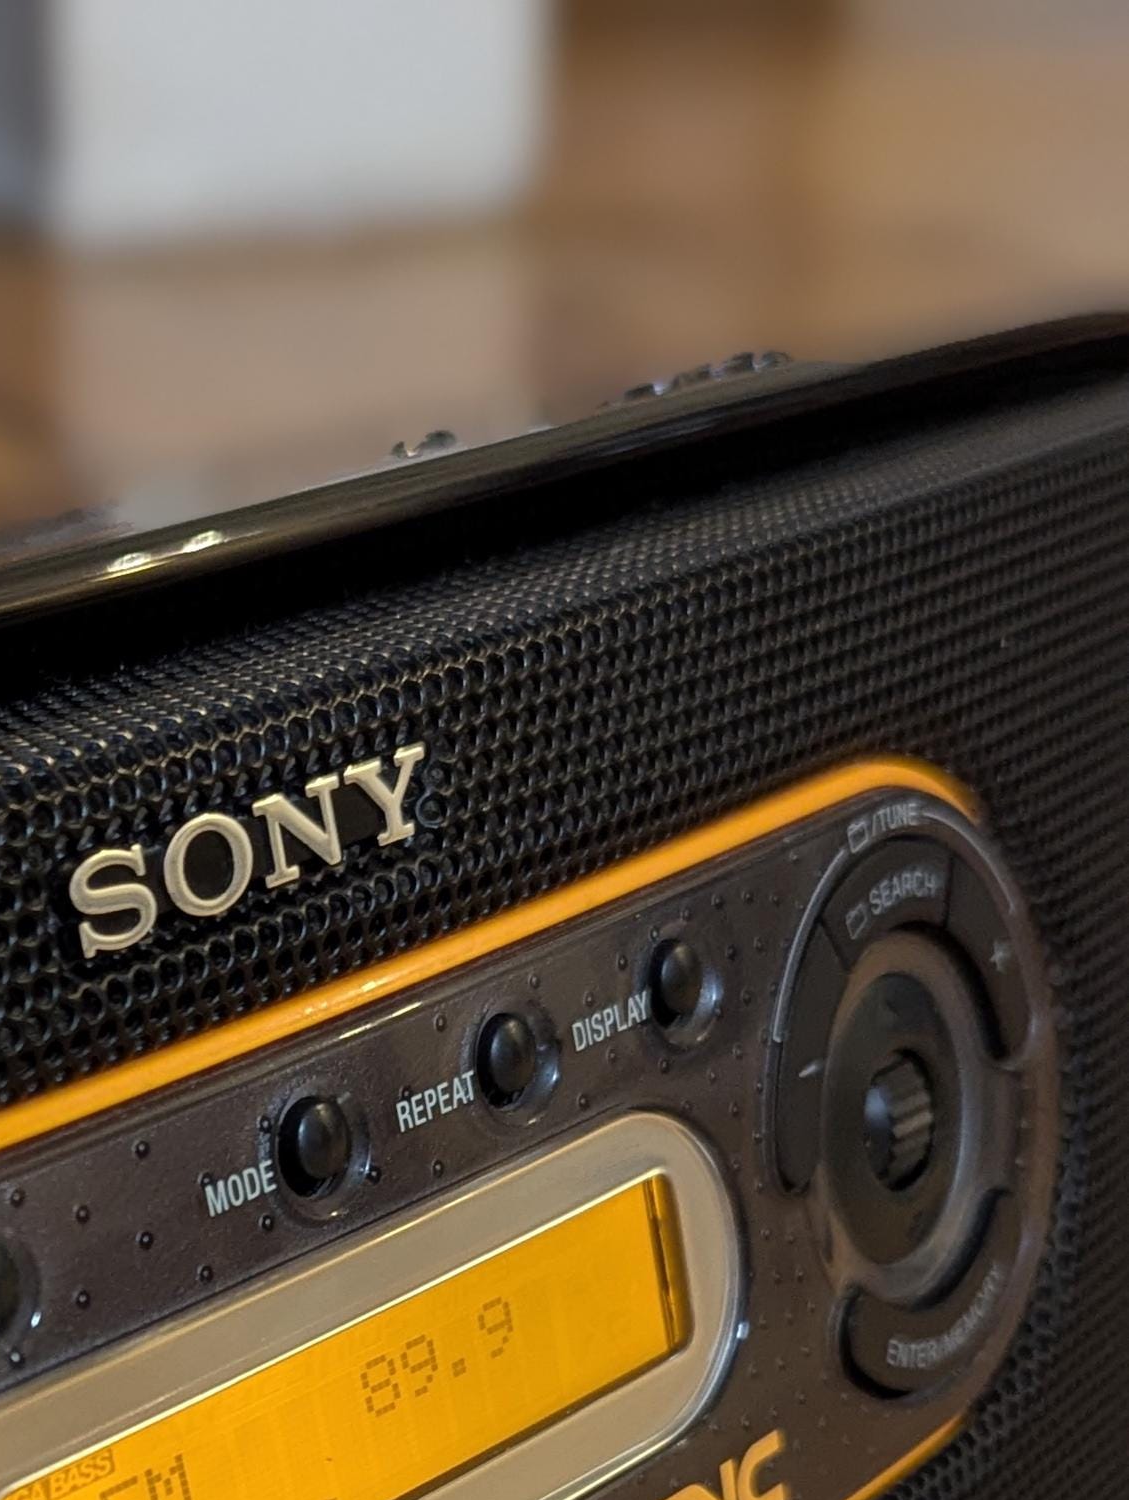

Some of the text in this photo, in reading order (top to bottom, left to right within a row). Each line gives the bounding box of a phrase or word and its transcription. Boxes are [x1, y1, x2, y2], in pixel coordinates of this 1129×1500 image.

[69, 741, 426, 959] SONY
[869, 869, 937, 915] SEARCH
[572, 991, 650, 1052] DISPLAY
[396, 1071, 476, 1133] REPEAT
[205, 1160, 276, 1217] MODE
[361, 1297, 514, 1417] 89.9
[50, 1452, 111, 1500] BASS
